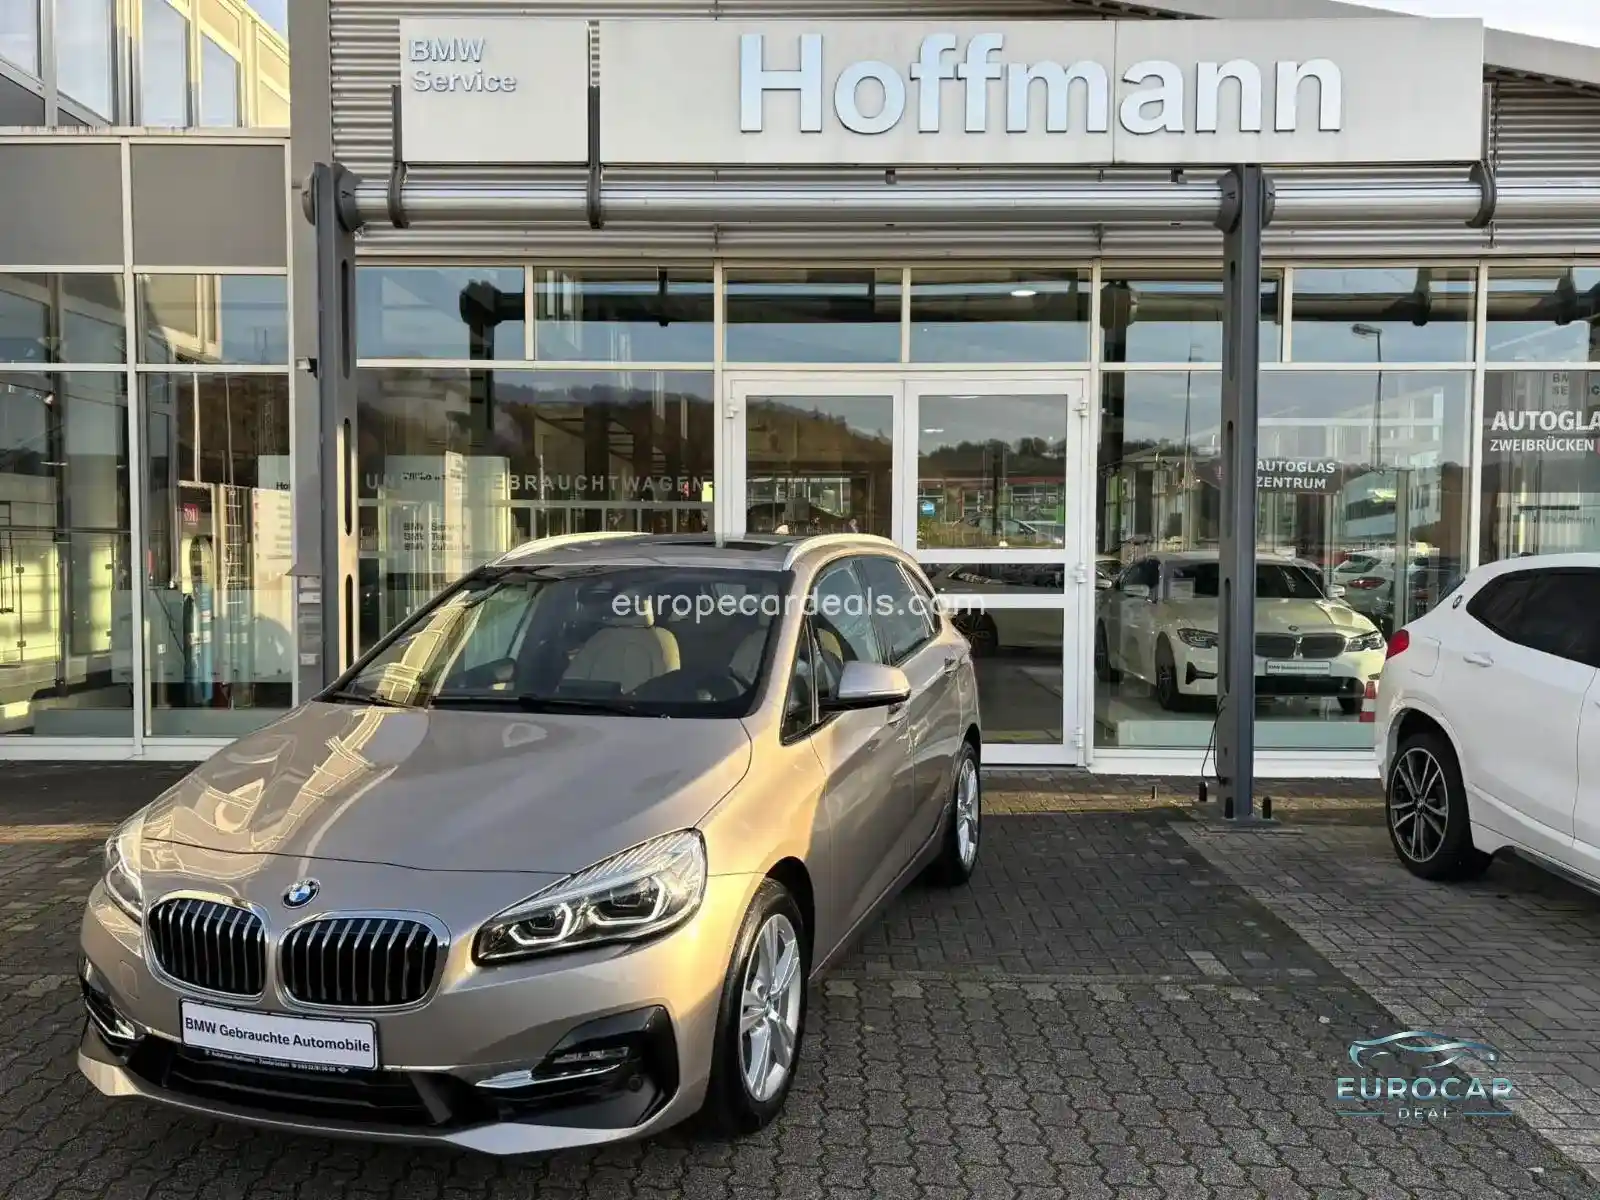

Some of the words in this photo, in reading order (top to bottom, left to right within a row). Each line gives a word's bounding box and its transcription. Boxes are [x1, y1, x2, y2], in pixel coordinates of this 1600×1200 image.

[410, 36, 485, 62] BMW
[412, 69, 517, 92] Service
[739, 33, 1343, 135] Hoffmann
[1490, 435, 1594, 452] ZWEIBRÜCKEN
[1257, 460, 1336, 473] AUTOGLAS
[476, 474, 704, 492] EBRAUCHTWAGEN
[1256, 476, 1327, 489] ZENTRUM
[185, 1017, 216, 1034] BMW
[219, 1025, 290, 1046] Gebrauchte
[293, 1035, 370, 1052] Automobile
